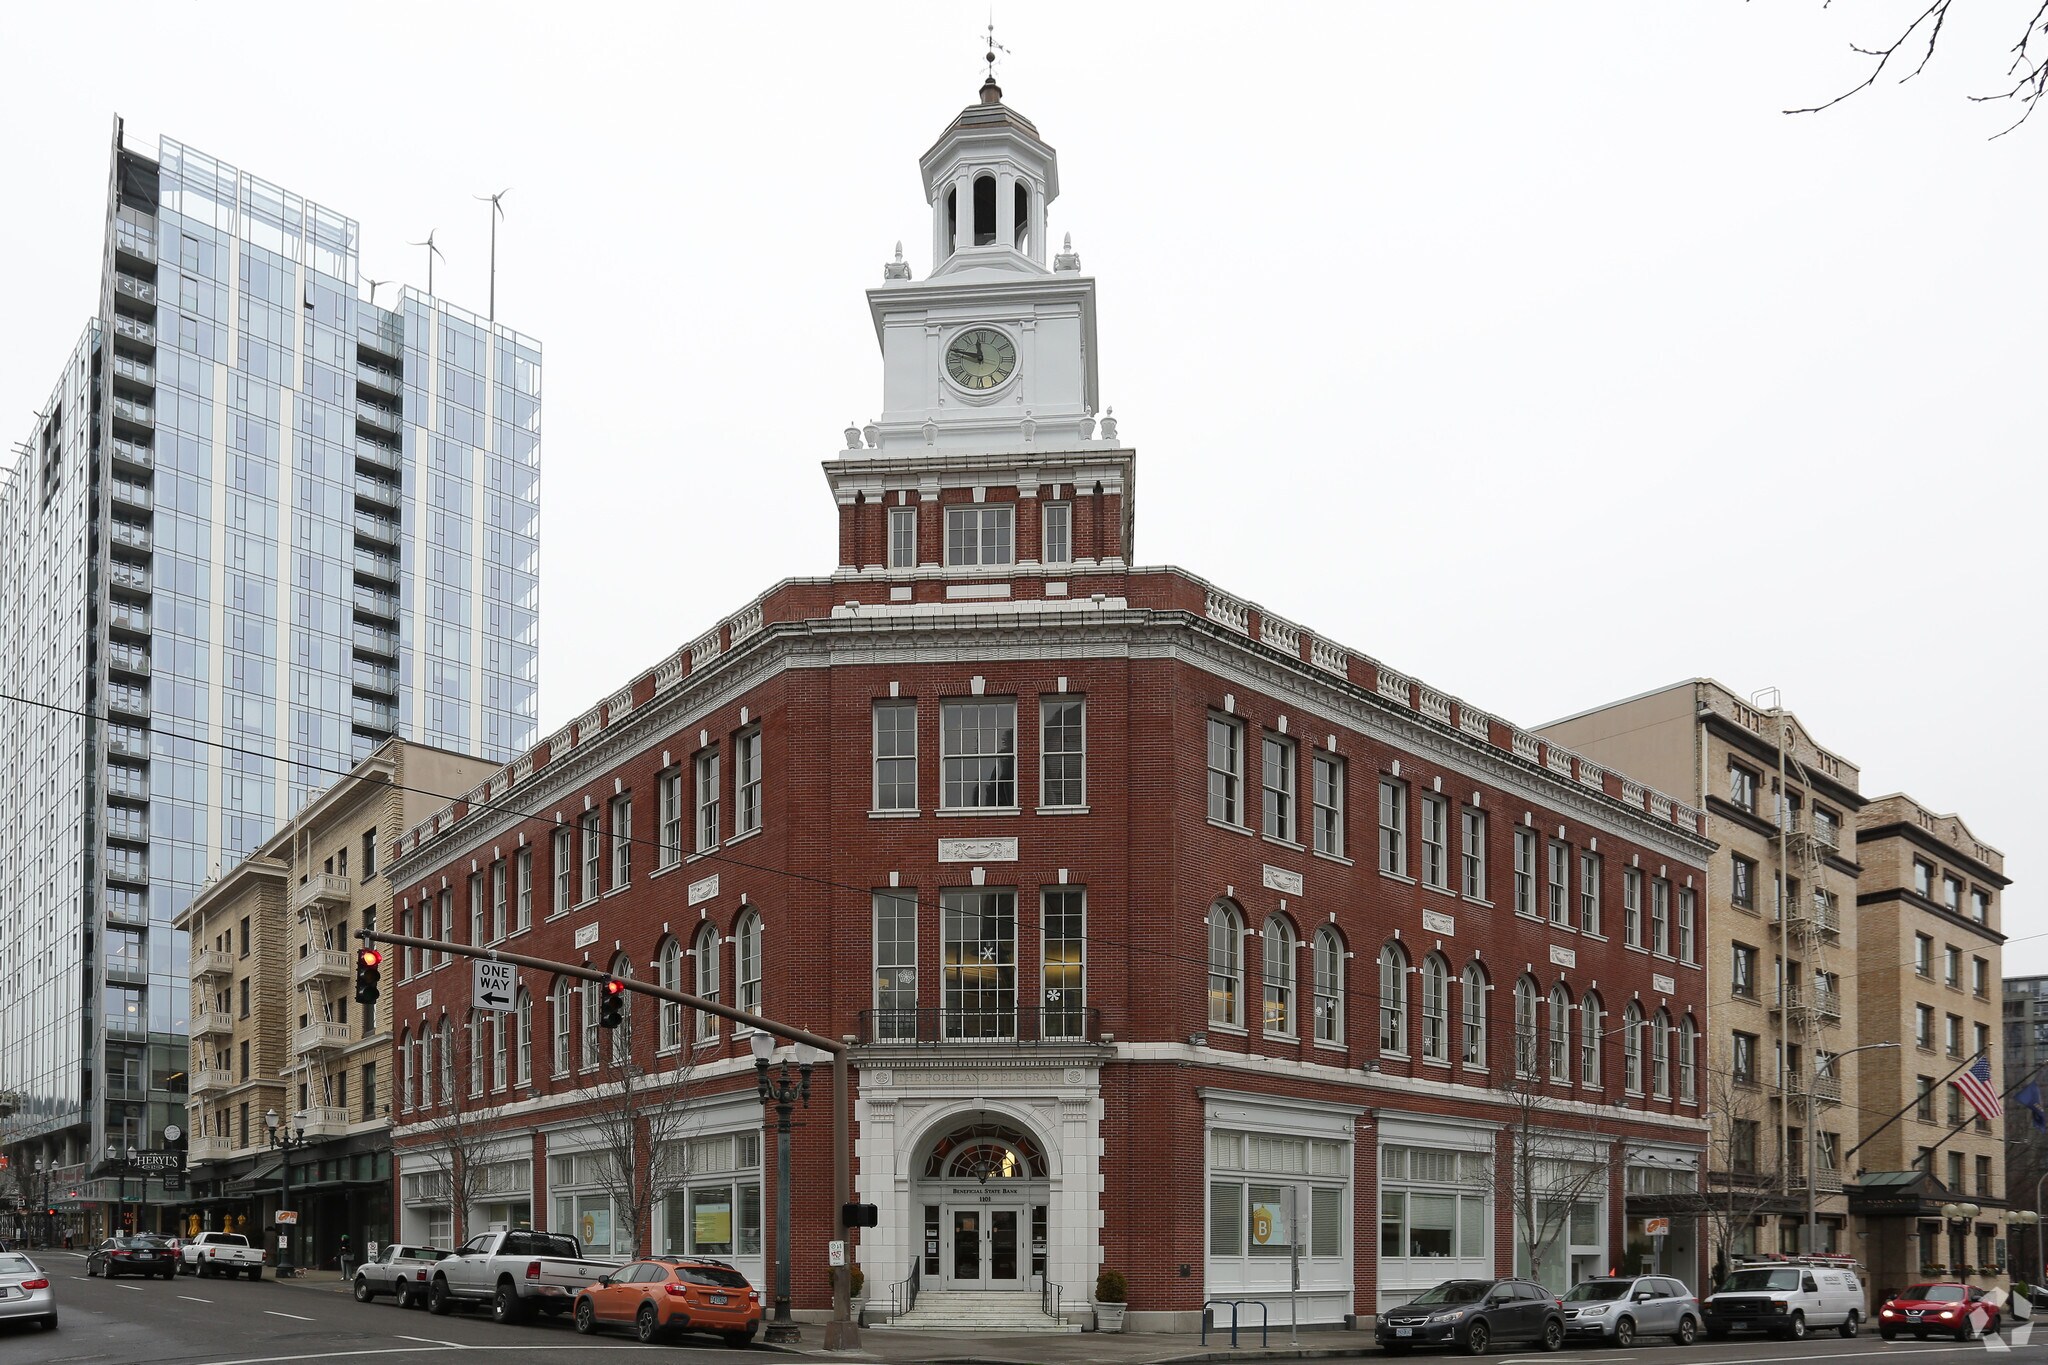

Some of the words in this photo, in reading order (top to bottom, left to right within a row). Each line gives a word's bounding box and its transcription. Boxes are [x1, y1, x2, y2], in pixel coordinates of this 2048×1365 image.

[481, 964, 509, 978] ONE
[480, 977, 510, 990] WAY
[897, 1073, 921, 1082] THE
[925, 1073, 989, 1082] PORTLAND
[992, 1072, 1059, 1082] TELEGRAM
[586, 1225, 592, 1237] B
[1259, 1221, 1267, 1235] B
